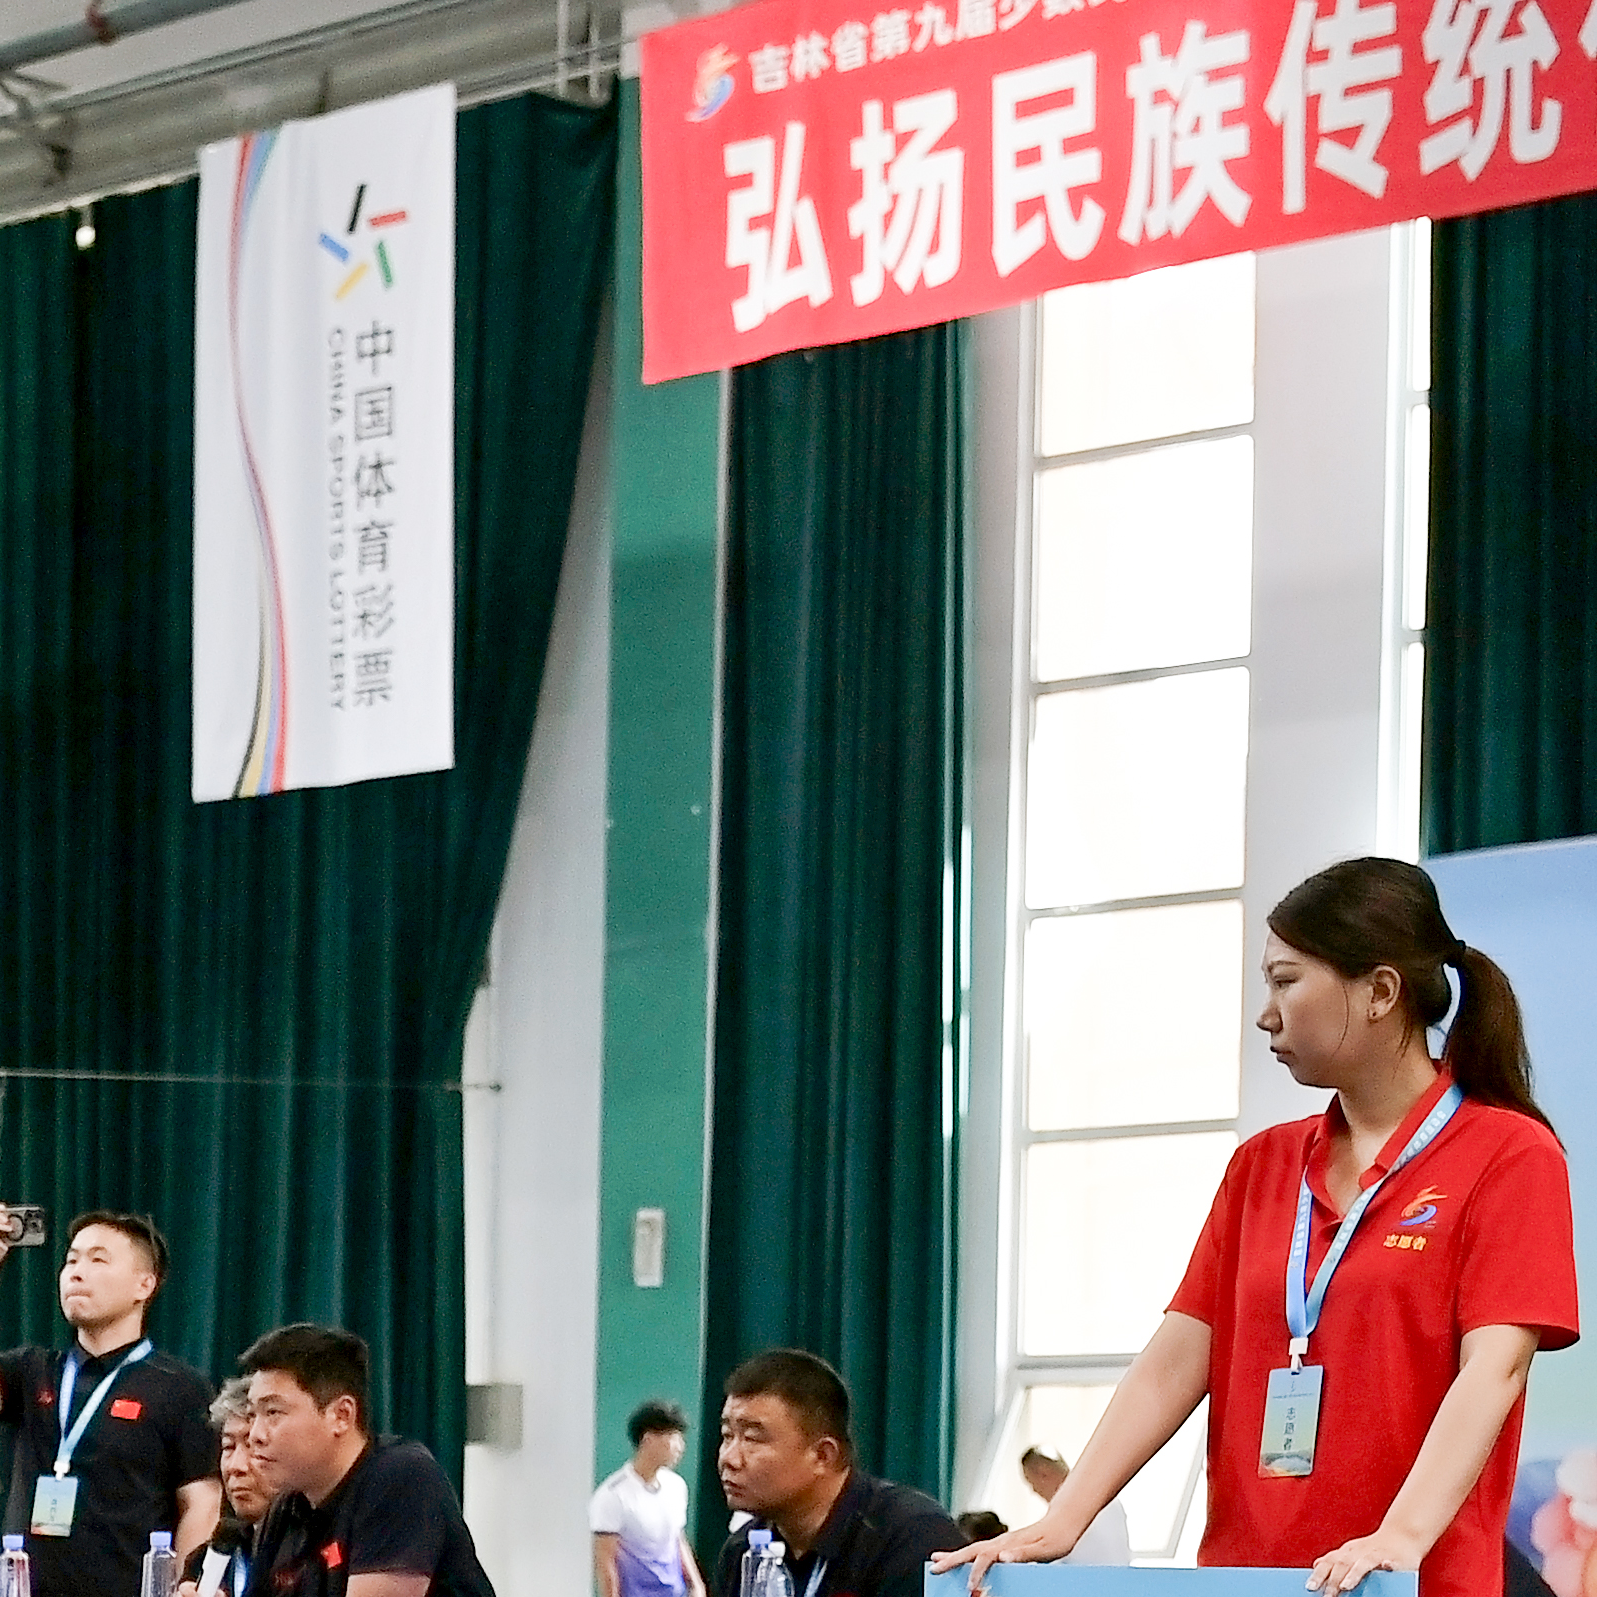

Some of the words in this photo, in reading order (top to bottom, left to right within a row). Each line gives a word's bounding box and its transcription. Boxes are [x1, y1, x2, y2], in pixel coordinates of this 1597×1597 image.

[748, 0, 1128, 94] 吉林省第九届少
[724, 0, 1597, 333] 弘扬民族传统
[328, 435, 345, 560] SPORTS
[353, 319, 396, 707] 中国体育彩票
[328, 569, 345, 711] LOTTERY
